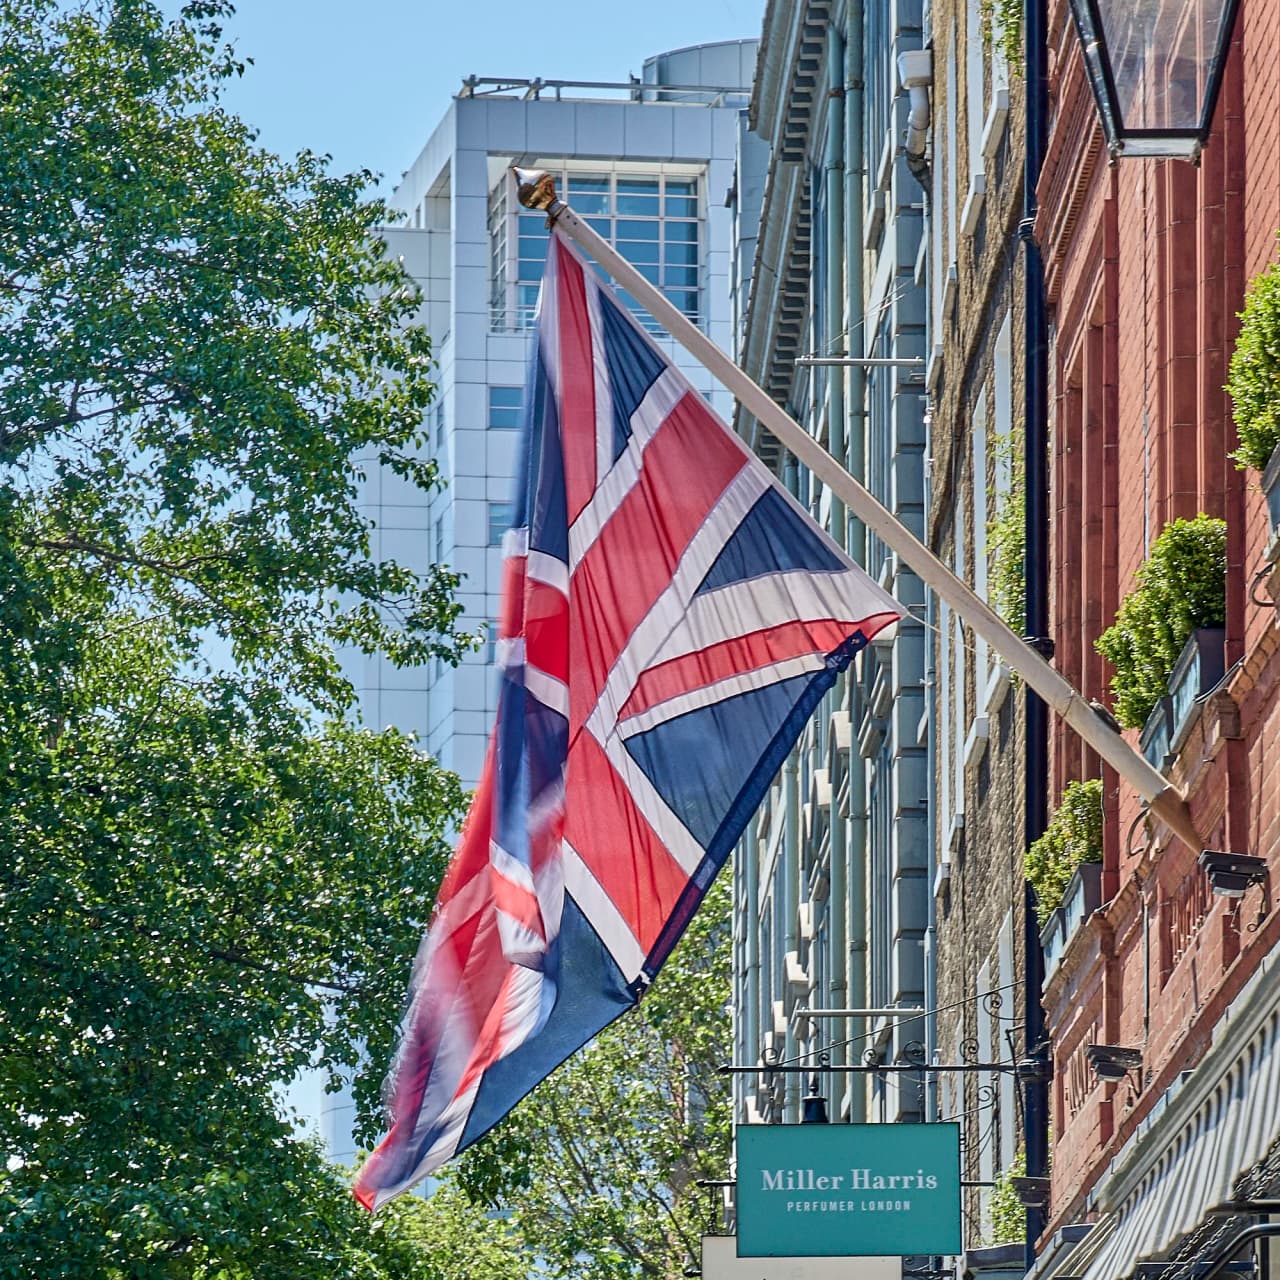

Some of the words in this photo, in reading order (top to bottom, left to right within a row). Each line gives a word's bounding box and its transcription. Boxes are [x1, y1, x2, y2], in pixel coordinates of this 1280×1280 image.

[761, 1169, 844, 1190] Miller
[850, 1168, 938, 1190] Harris
[787, 1201, 854, 1211] PERFUMER
[861, 1201, 911, 1211] LONDON
